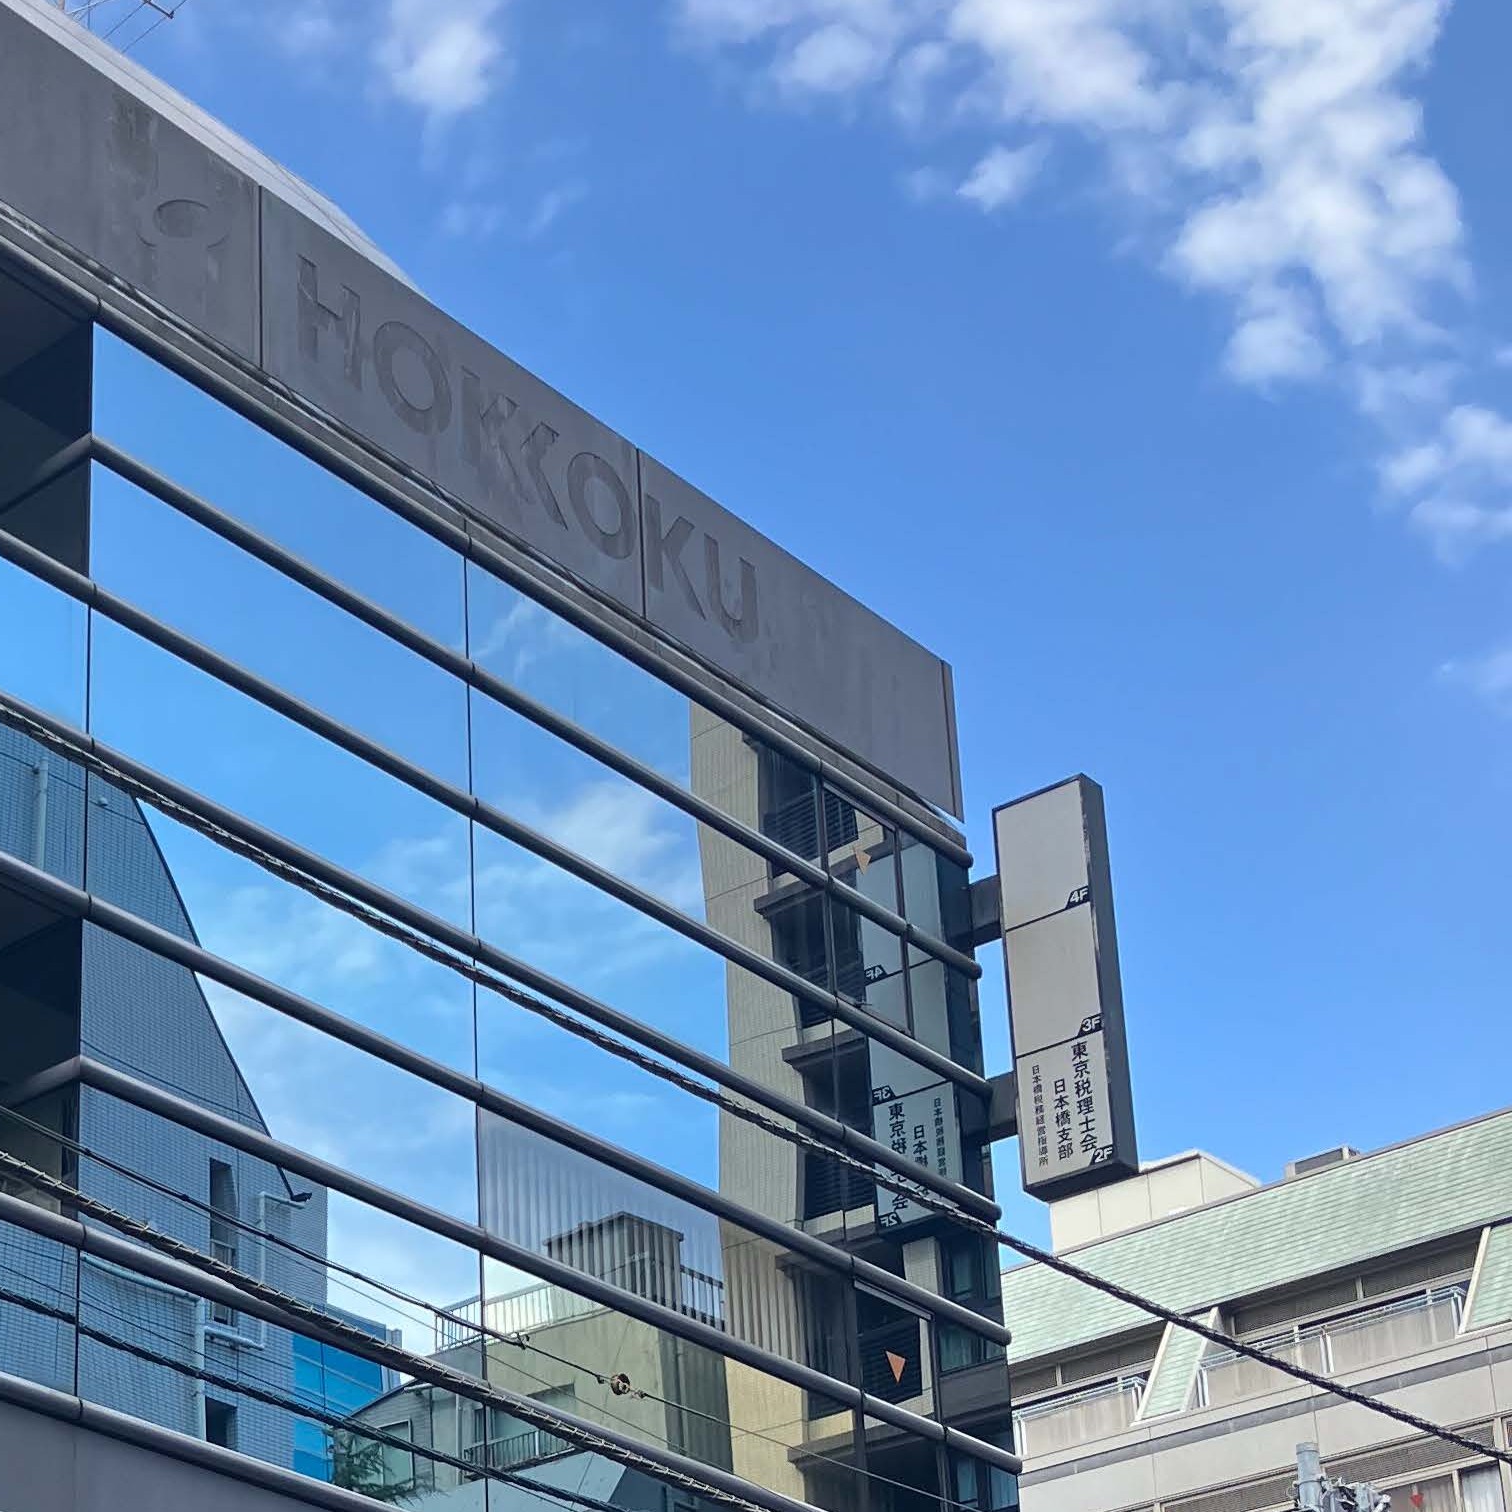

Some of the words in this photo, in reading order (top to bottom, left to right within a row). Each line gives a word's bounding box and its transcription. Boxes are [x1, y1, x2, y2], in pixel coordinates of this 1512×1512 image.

[1070, 888, 1088, 904] 4F
[1082, 1016, 1102, 1032] 3F
[1071, 1041, 1098, 1153] 東京税理士会
[1054, 1078, 1074, 1161] 日本橋支部
[1093, 1147, 1113, 1163] 2F
